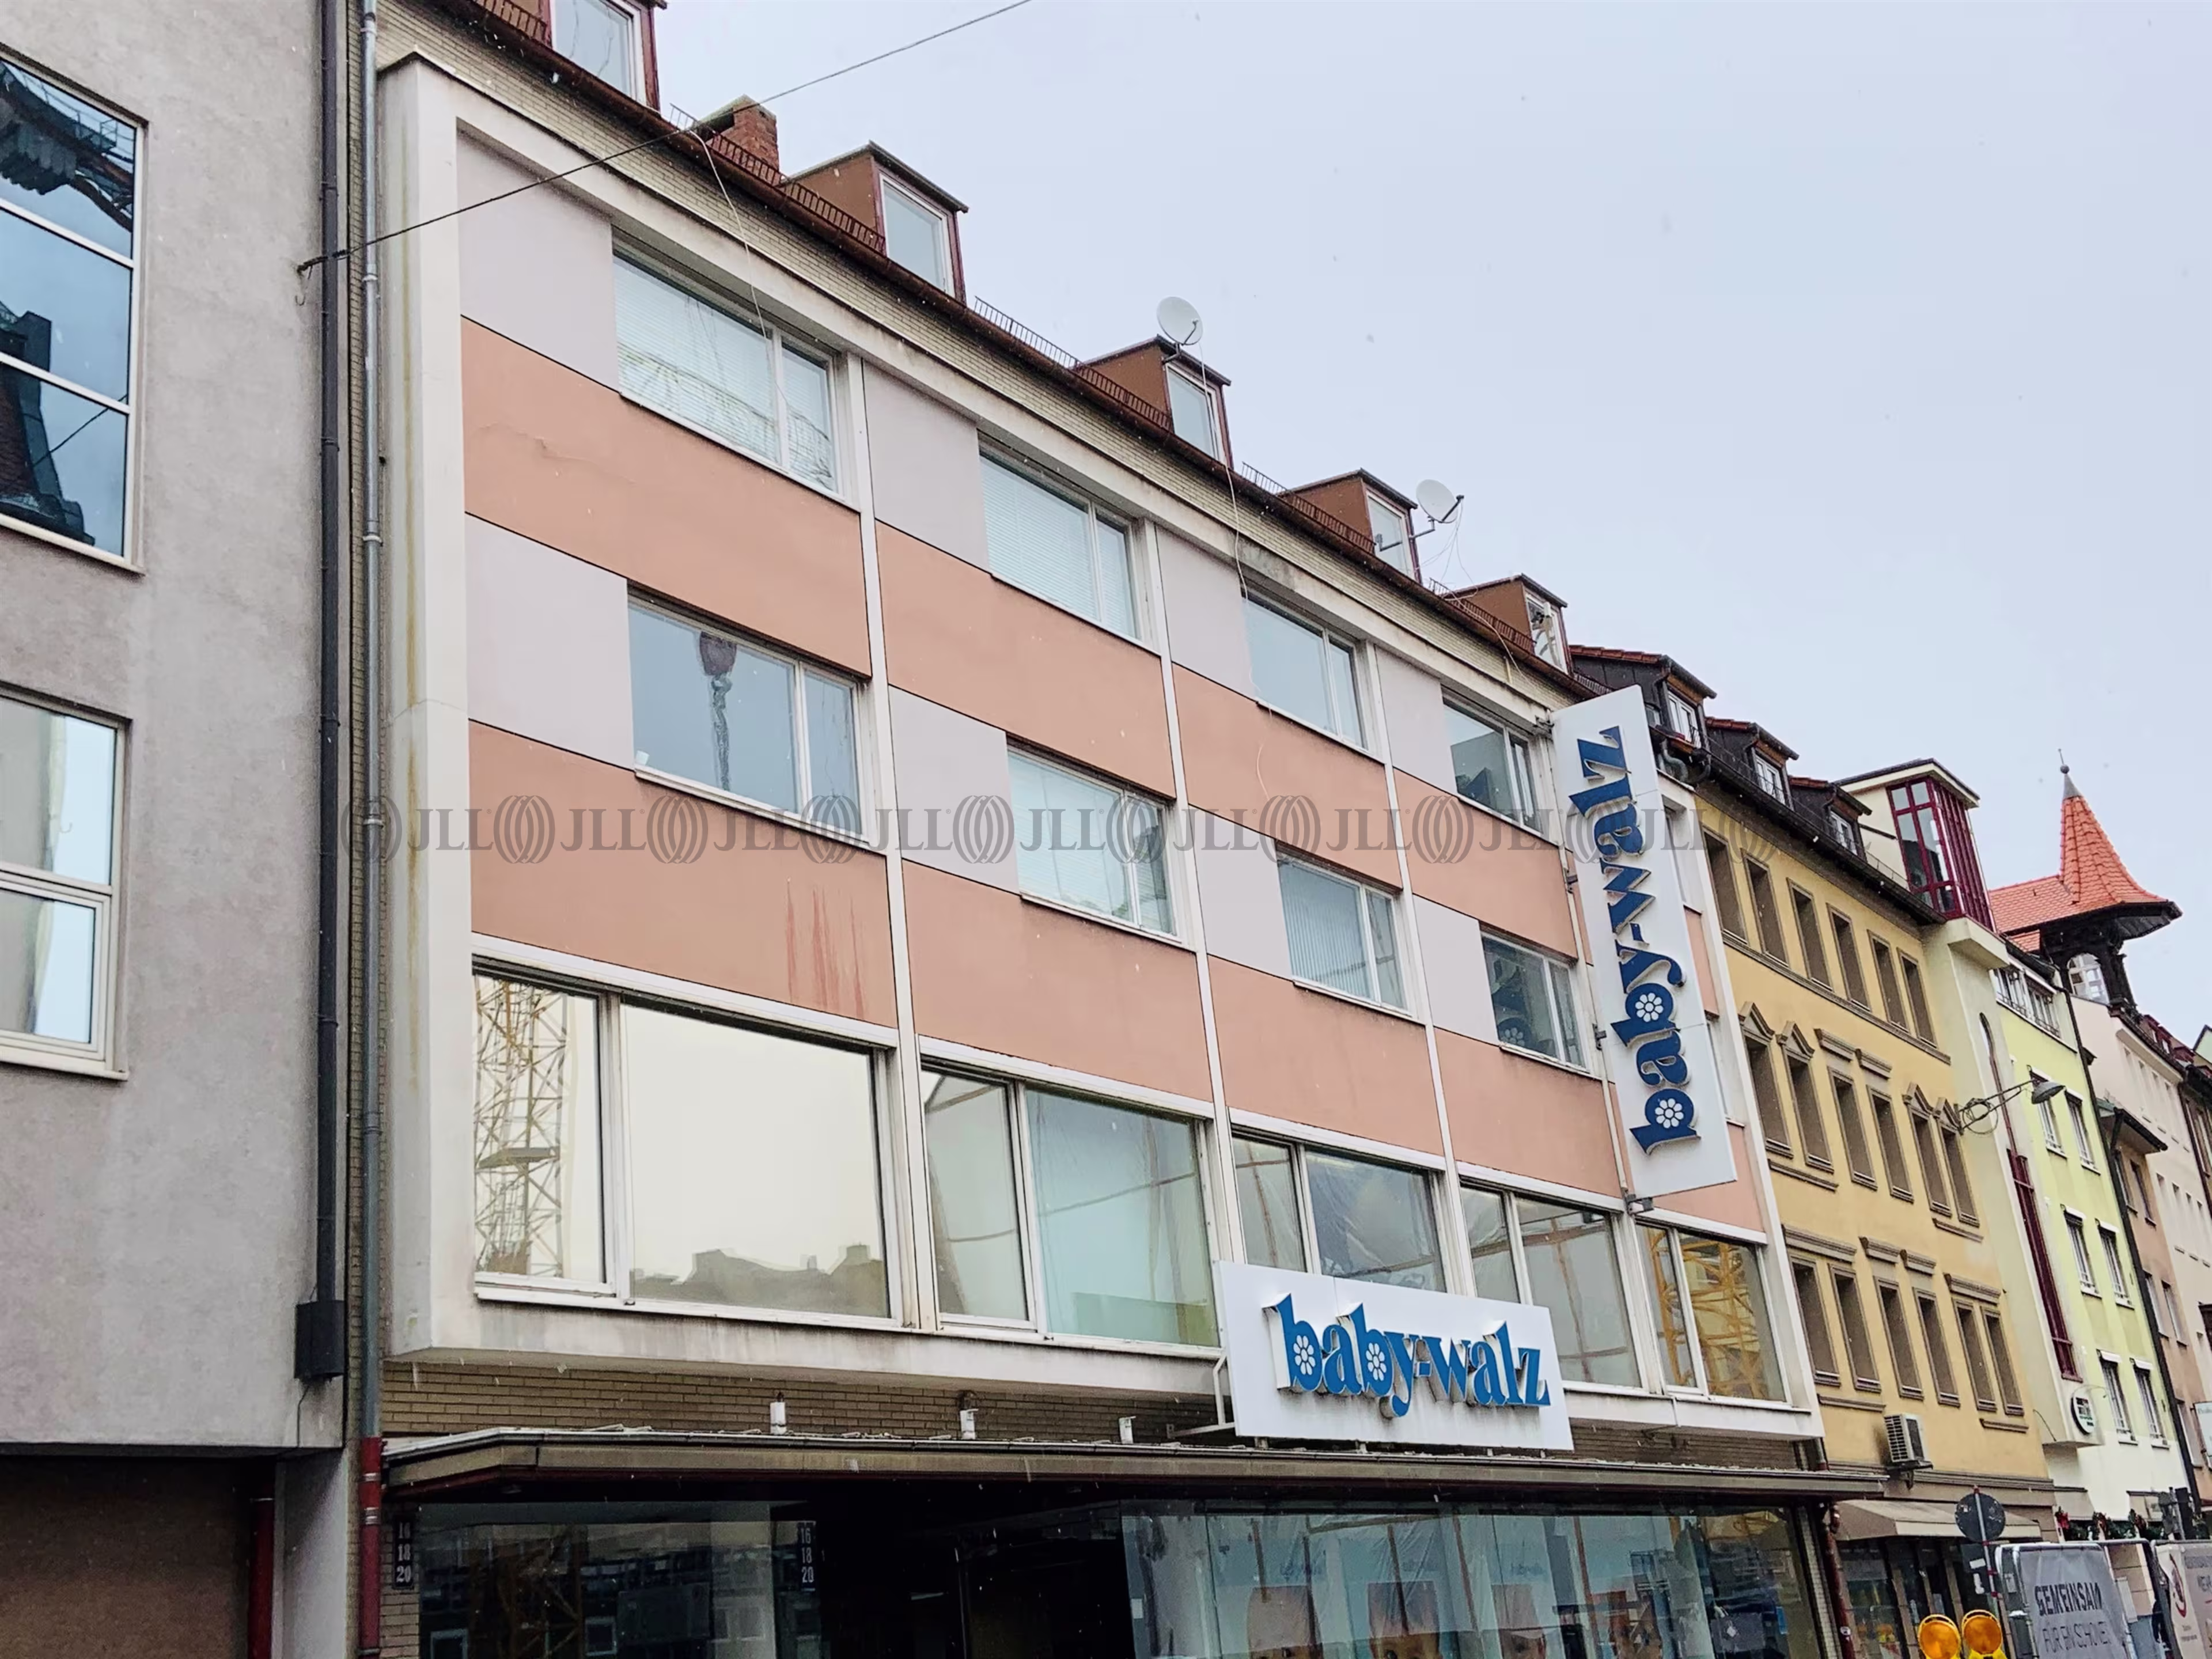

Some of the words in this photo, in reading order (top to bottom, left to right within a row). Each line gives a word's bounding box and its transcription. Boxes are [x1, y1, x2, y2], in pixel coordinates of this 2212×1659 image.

[1569, 725, 1700, 1154] baby-walz
[1264, 1293, 1551, 1418] baby-walz
[801, 1528, 811, 1544] 16
[398, 1544, 411, 1560] 18
[801, 1547, 812, 1563] 18
[396, 1566, 411, 1583] 20
[801, 1566, 814, 1583] 20
[2034, 1582, 2102, 1616] GEMEINSAM
